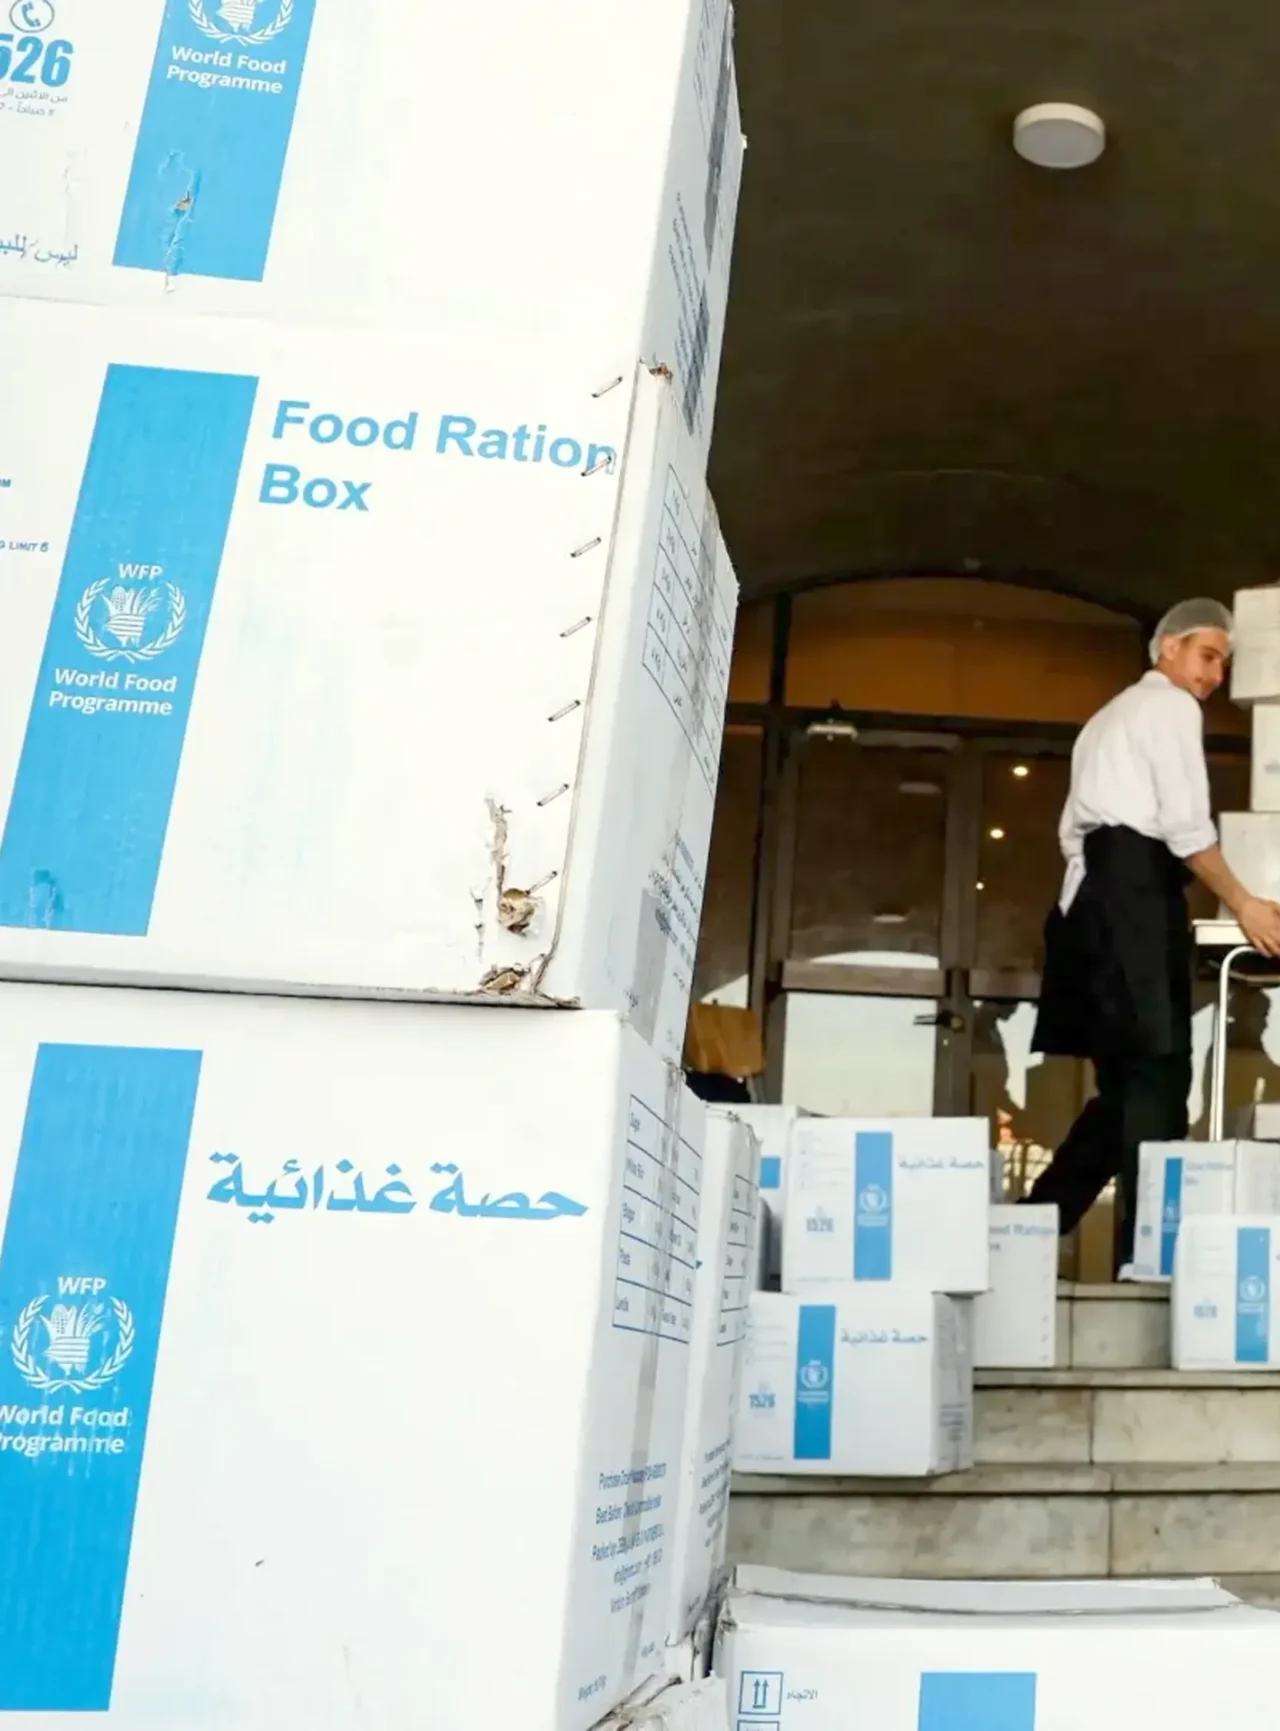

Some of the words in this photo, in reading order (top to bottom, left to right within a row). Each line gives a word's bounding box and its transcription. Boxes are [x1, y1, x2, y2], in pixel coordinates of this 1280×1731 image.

[0, 32, 73, 88] 526
[171, 45, 232, 67] World
[237, 54, 288, 75] Food
[167, 64, 284, 94] Programme
[272, 399, 417, 451] Food
[436, 413, 618, 475] Ration
[259, 463, 372, 512] Box
[118, 563, 164, 580] WFP
[55, 668, 120, 690] World
[125, 674, 177, 693] Food
[49, 690, 173, 717] Programme
[206, 1151, 418, 1225] غذائية
[429, 1162, 590, 1221] حصة
[57, 1276, 107, 1295] WFP
[0, 1404, 64, 1426] World
[70, 1406, 129, 1428] Food
[0, 1431, 125, 1457] rogramme
